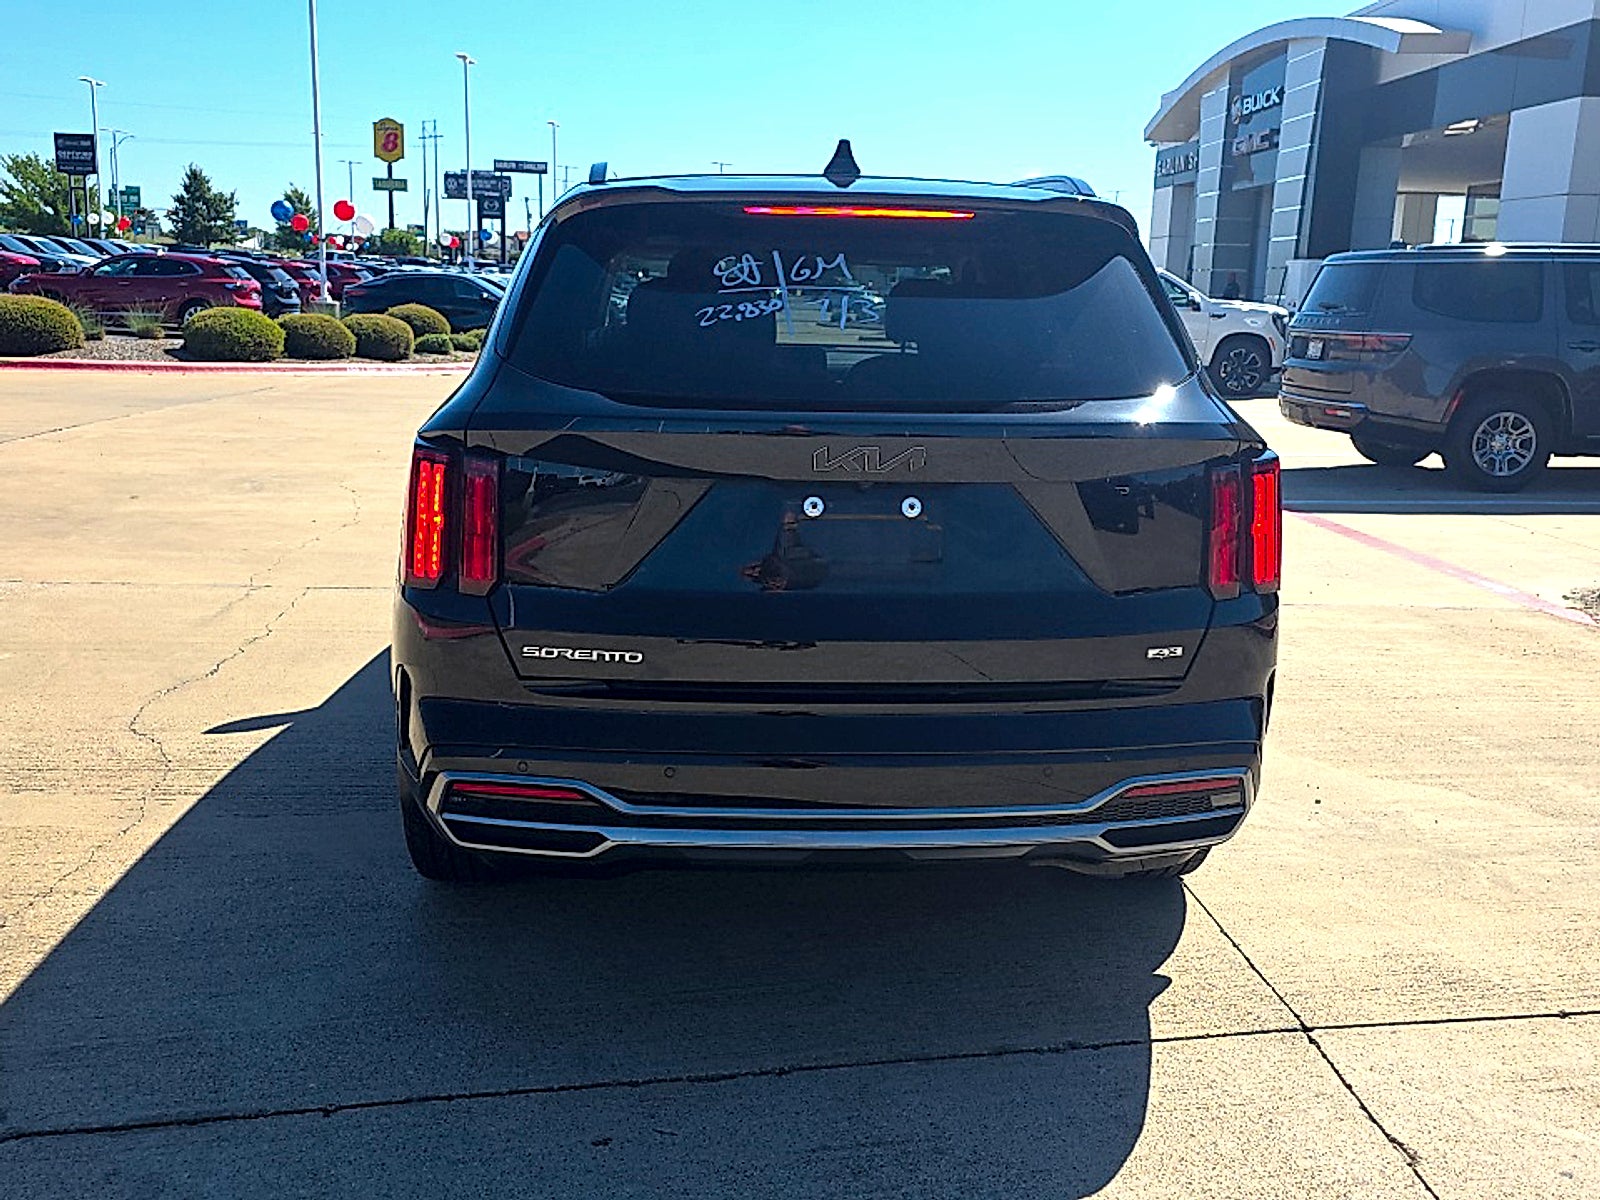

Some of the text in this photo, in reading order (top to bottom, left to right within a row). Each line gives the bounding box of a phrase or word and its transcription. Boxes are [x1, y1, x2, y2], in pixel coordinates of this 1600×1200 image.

[1242, 86, 1280, 115] BUICK
[382, 132, 399, 152] 8
[813, 446, 926, 472] KIA
[521, 646, 643, 663] SORENTO
